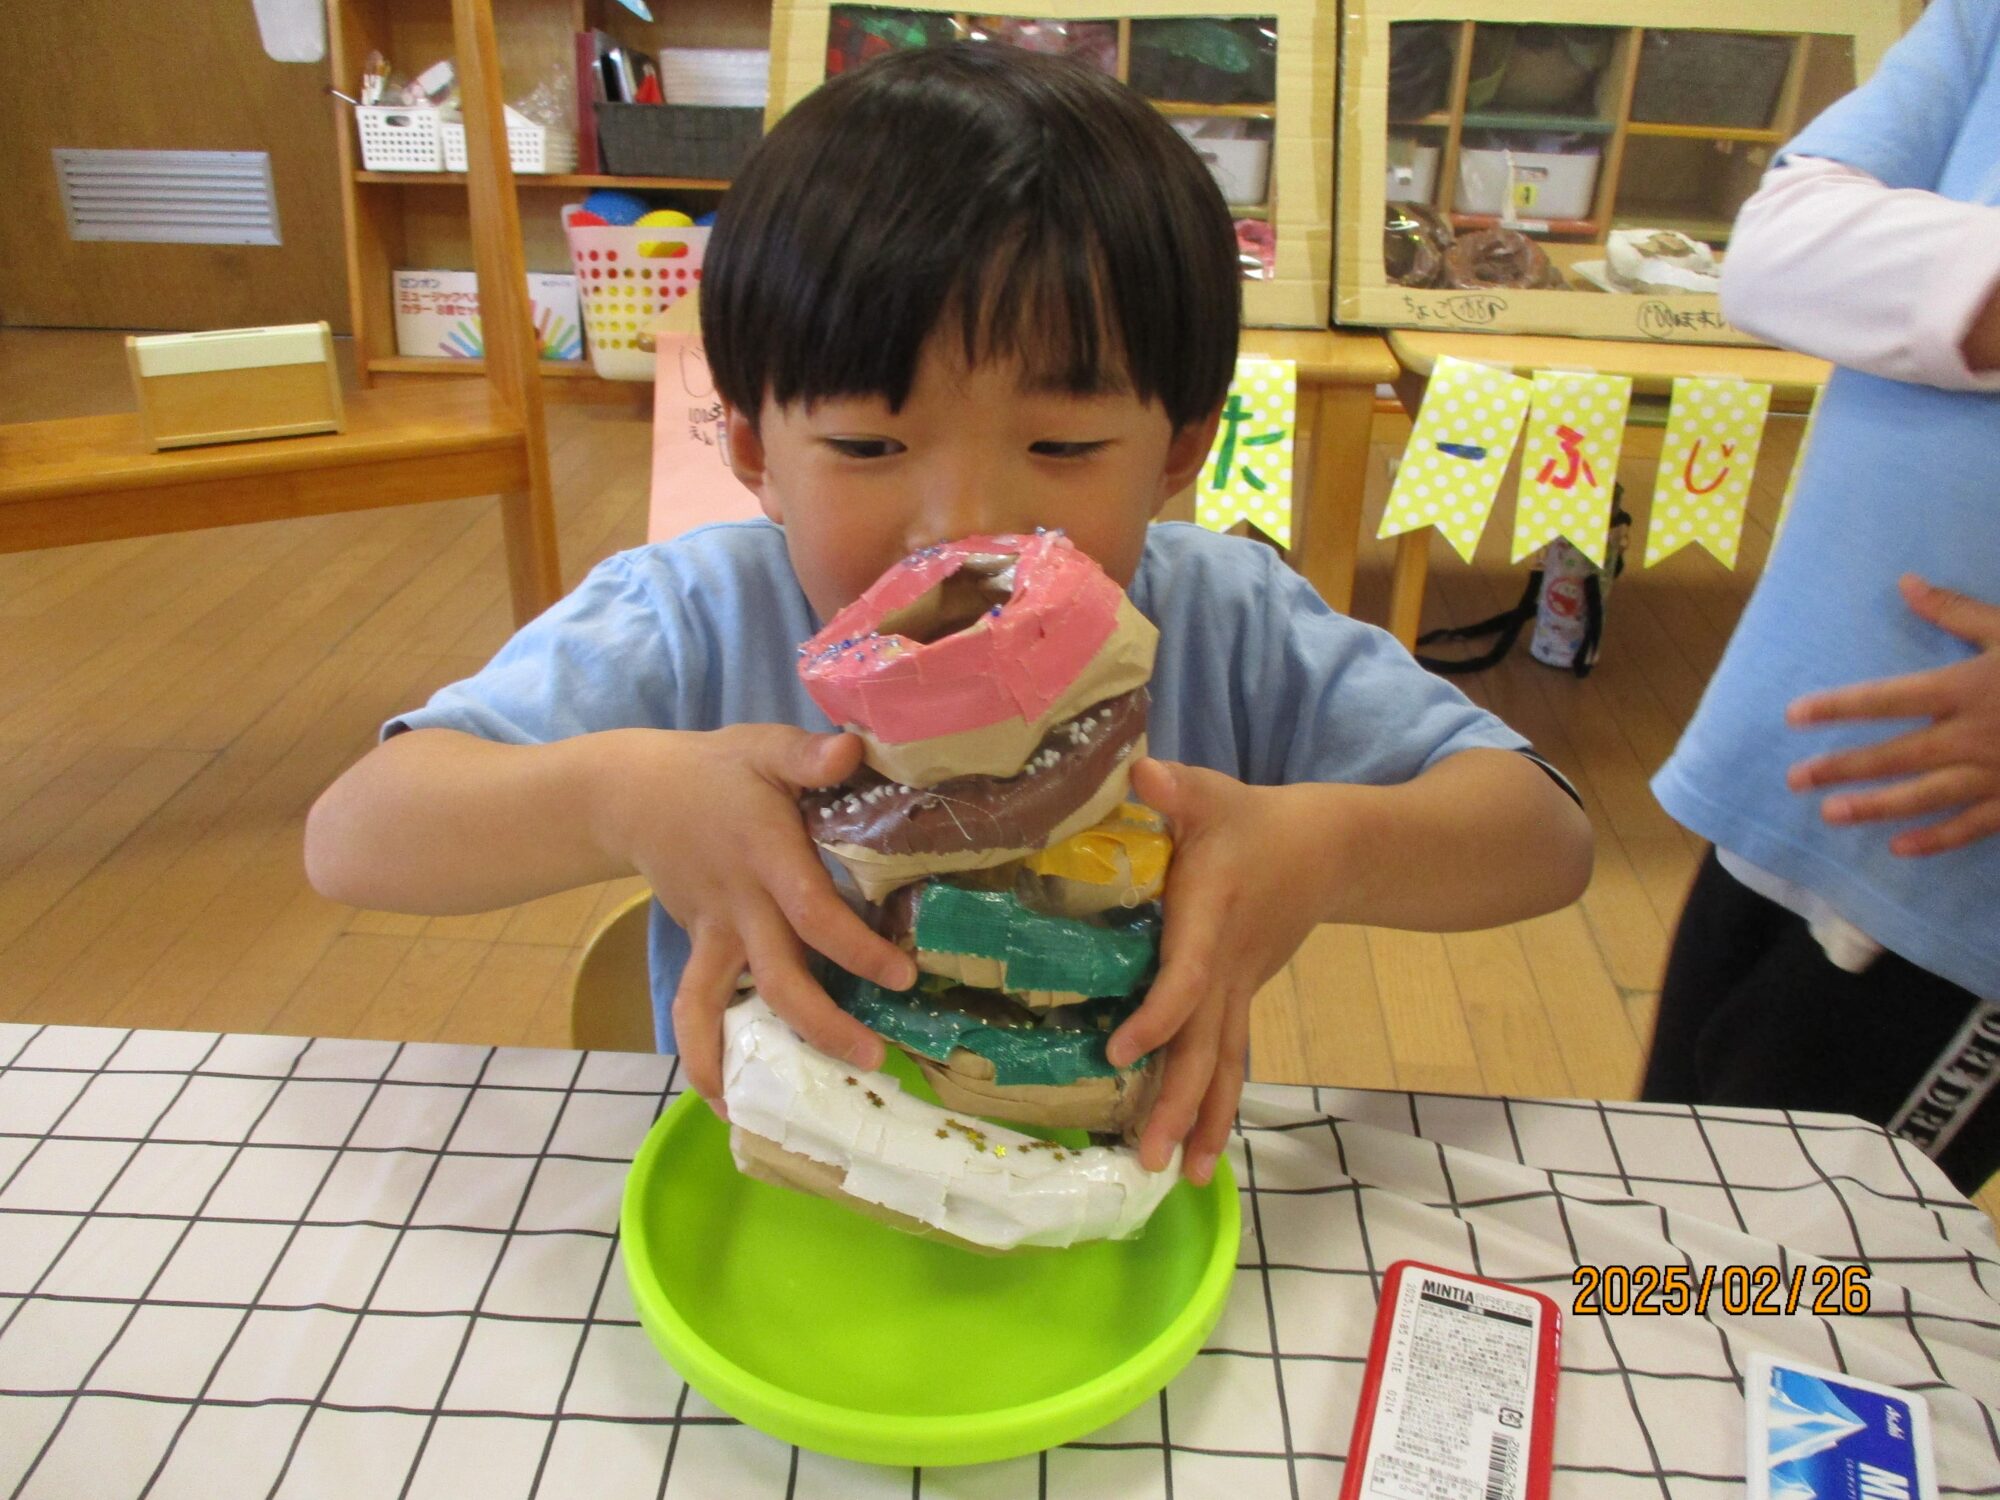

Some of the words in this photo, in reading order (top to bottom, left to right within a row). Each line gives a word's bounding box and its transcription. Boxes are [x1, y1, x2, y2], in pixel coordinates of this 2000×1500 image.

[1213, 395, 1287, 491] た
[1535, 425, 1598, 489] ふ
[1684, 439, 1735, 495] じ
[1421, 1278, 1475, 1304] MINTIA
